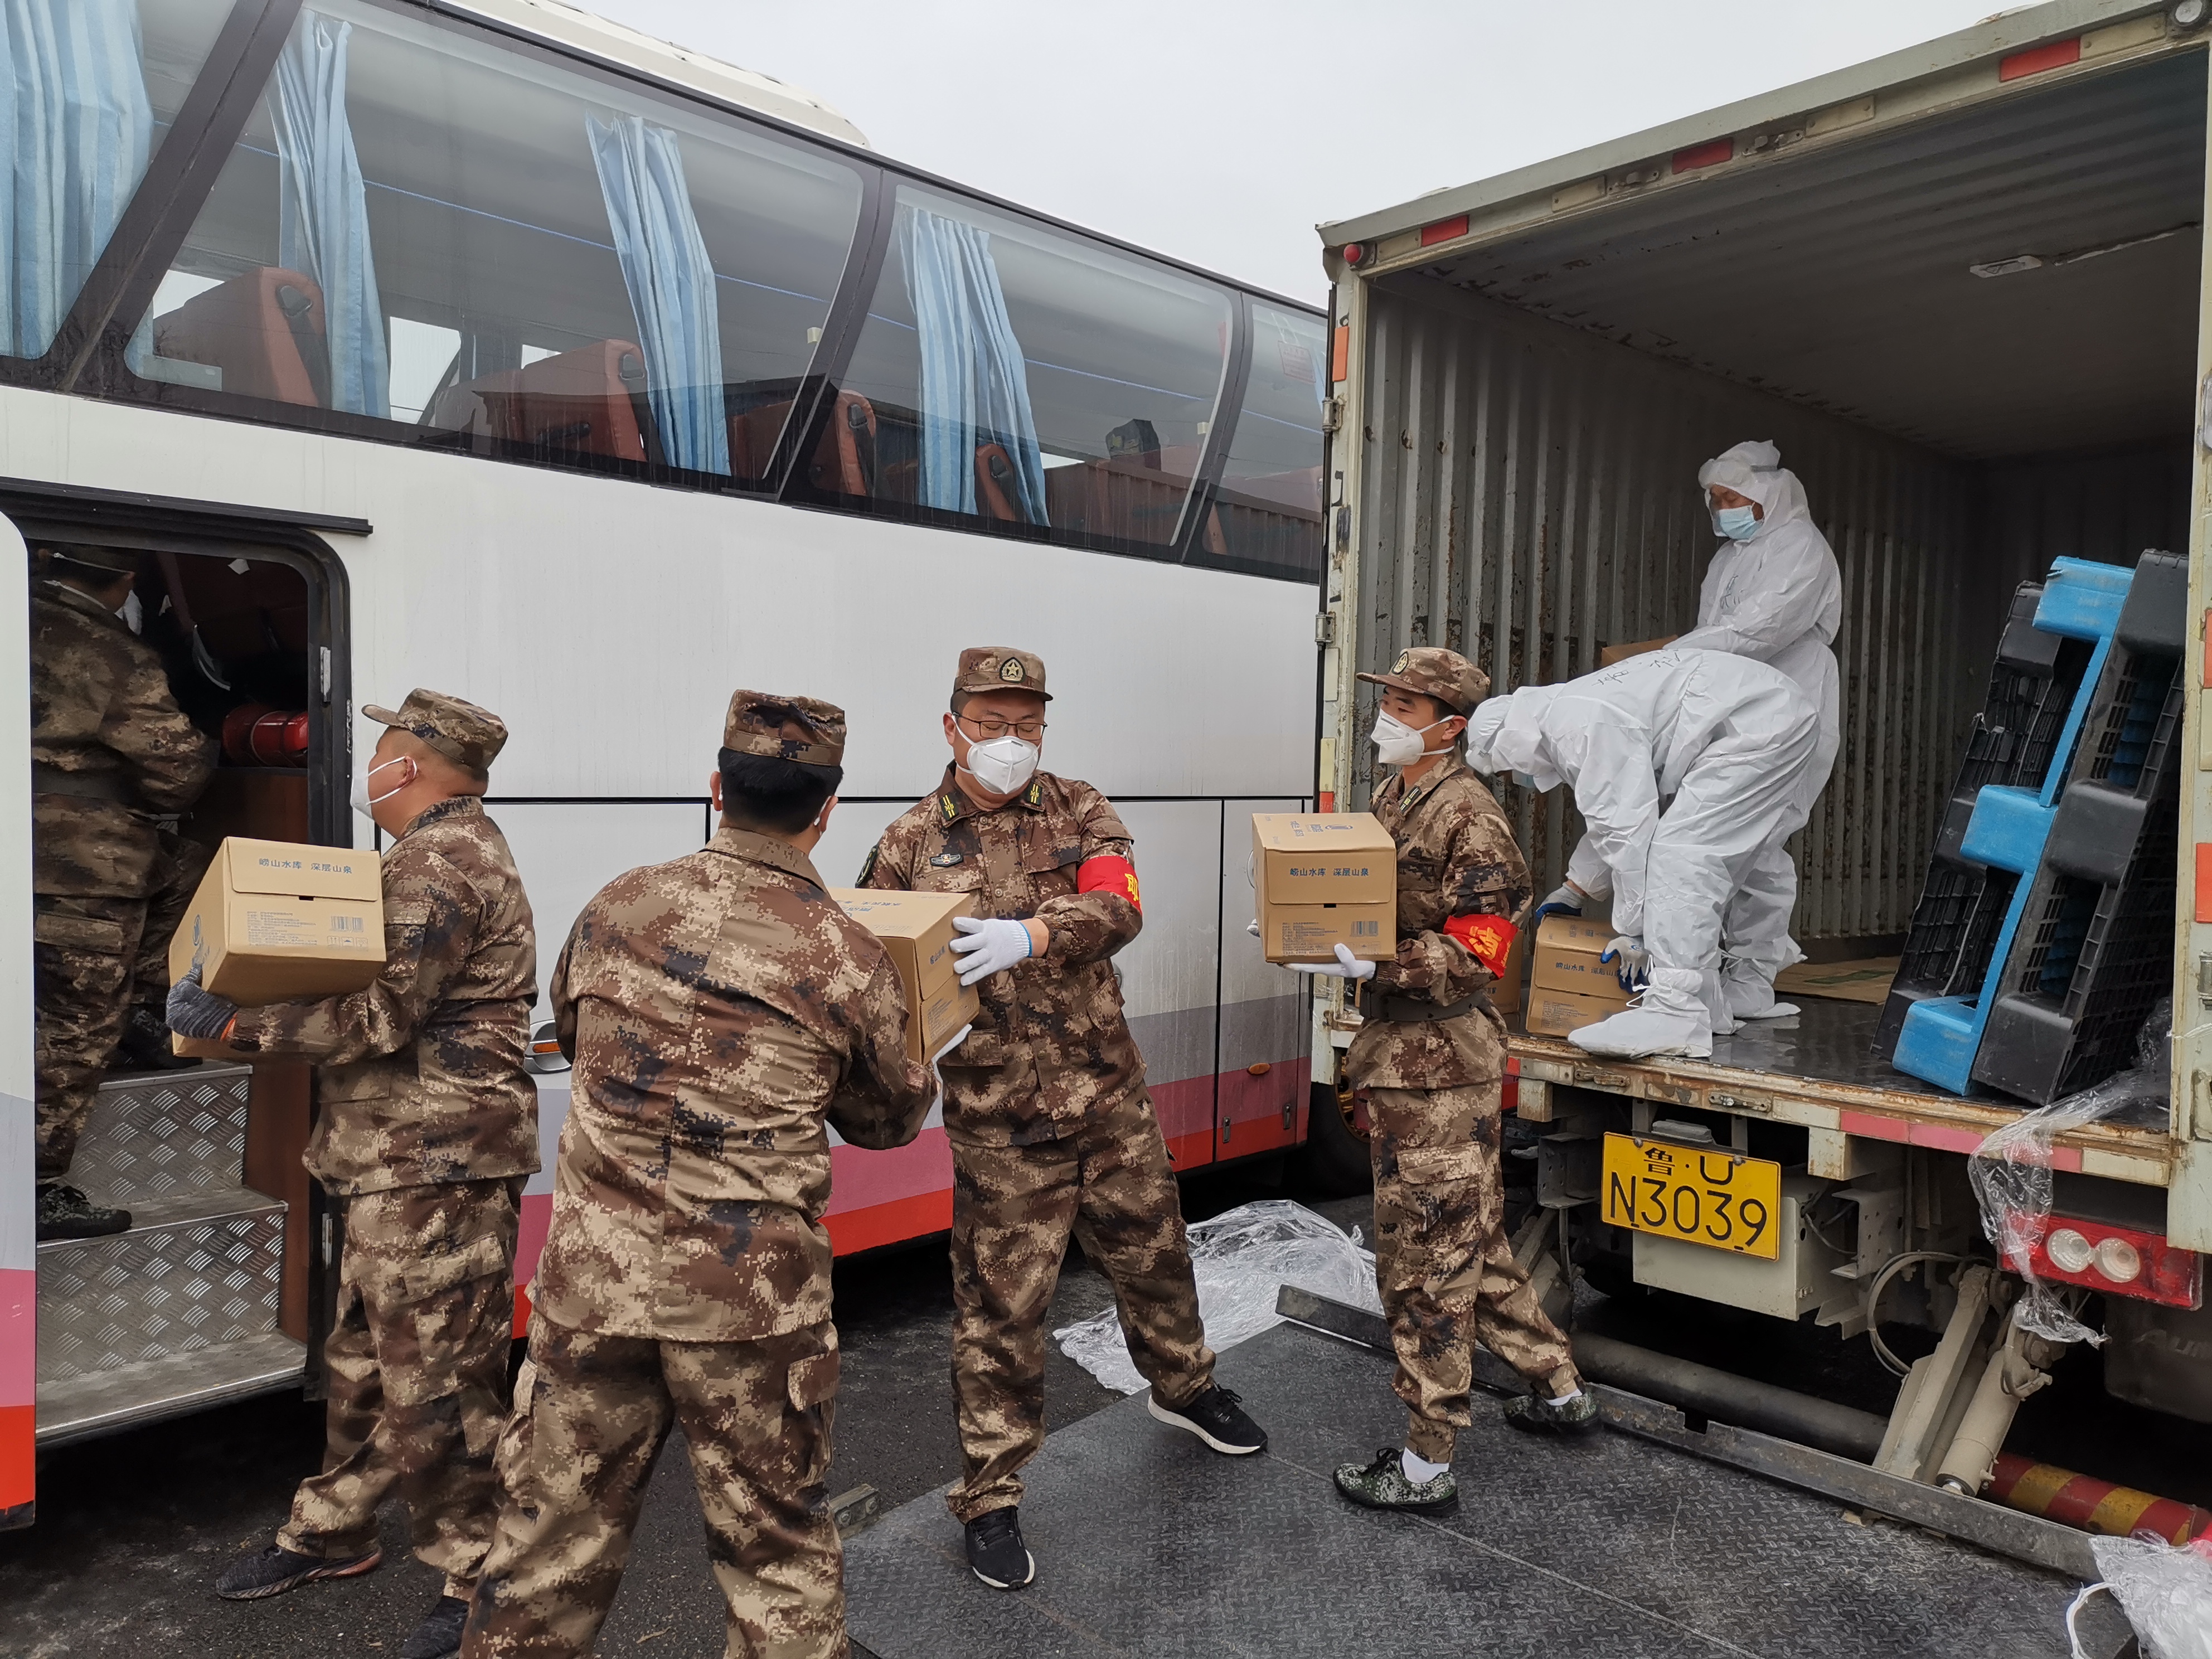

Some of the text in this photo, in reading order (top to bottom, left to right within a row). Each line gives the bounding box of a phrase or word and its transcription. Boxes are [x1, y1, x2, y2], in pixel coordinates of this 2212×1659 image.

[944, 803, 954, 812] MB
[259, 858, 352, 874] 崂山水库 深层山泉
[1289, 867, 1369, 877] 崂山水库 深层山泉
[1610, 1171, 1768, 1248] N3039
